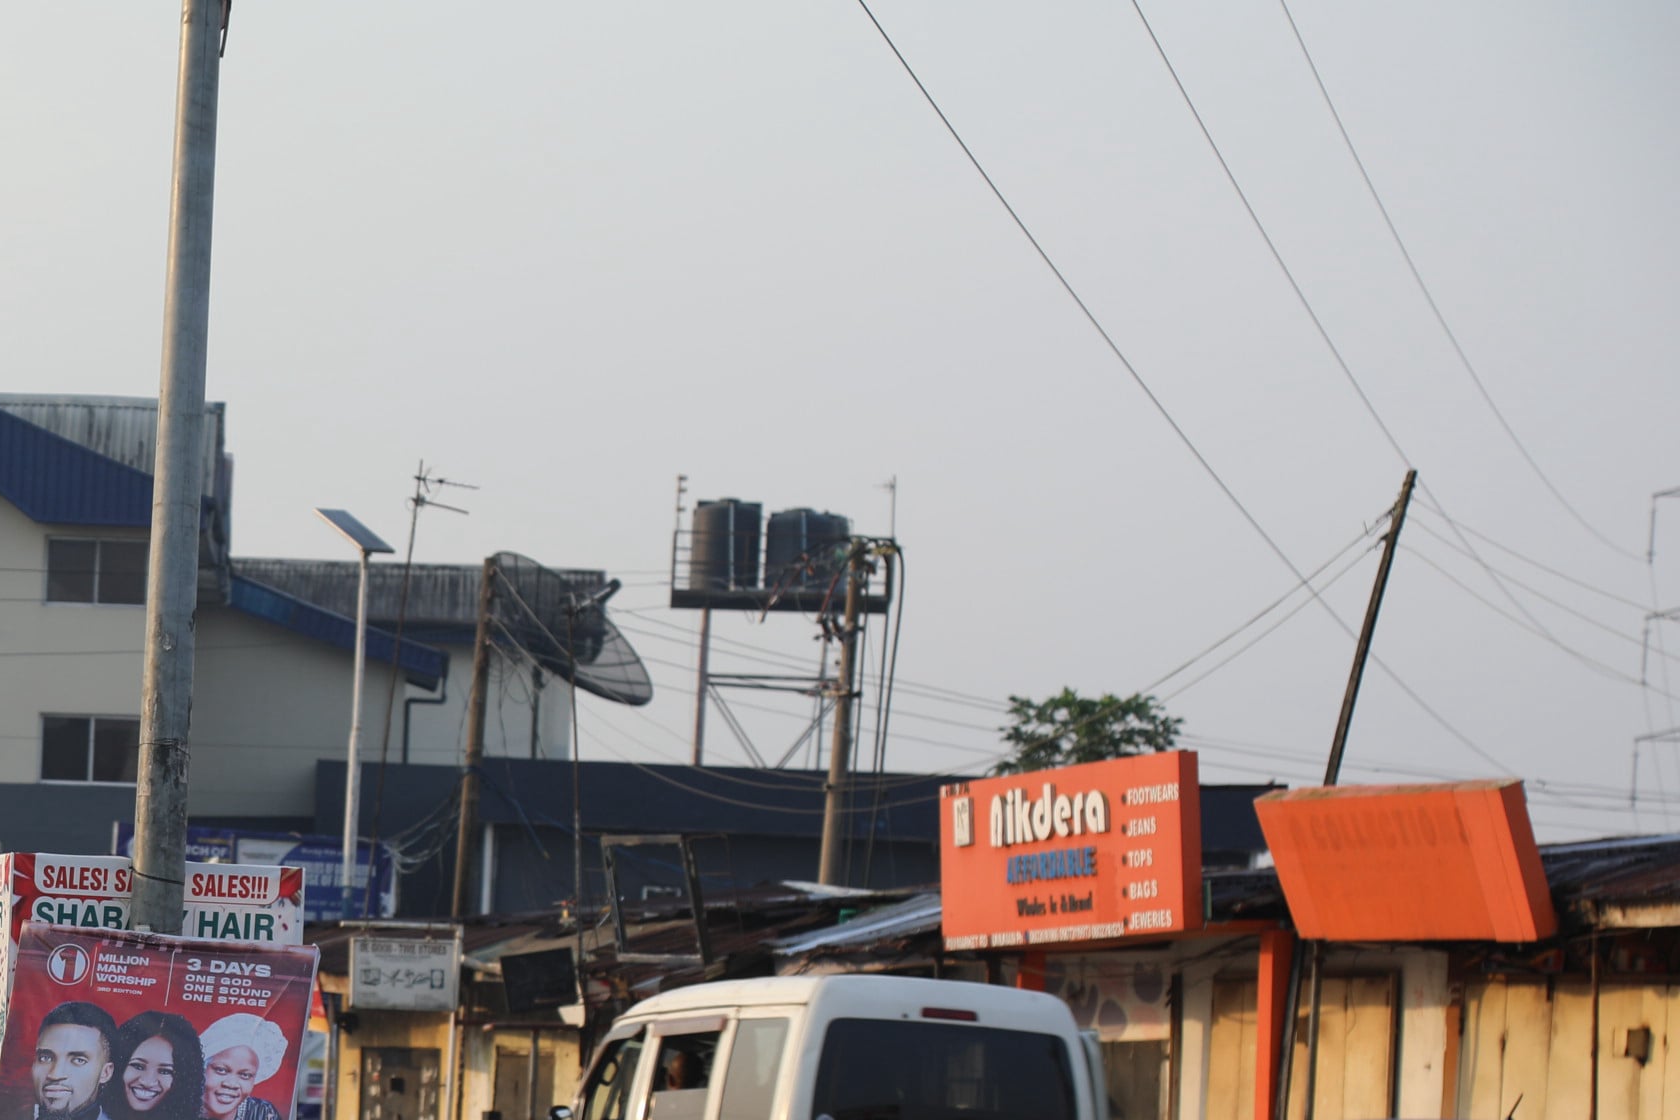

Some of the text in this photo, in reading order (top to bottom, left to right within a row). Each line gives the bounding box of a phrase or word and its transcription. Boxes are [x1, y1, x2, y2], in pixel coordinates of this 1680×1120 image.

[1127, 783, 1179, 806] FOOTWEARS
[1127, 816, 1157, 837] JEANS
[1006, 846, 1097, 885] AFFORDABLE
[1128, 848, 1153, 867] TOPS
[43, 864, 108, 892] SALES!
[191, 873, 269, 900] SALES!!!
[1129, 879, 1158, 900] BAGS
[198, 910, 275, 941] HAIR
[1128, 909, 1173, 930] JEWERIES
[97, 963, 128, 975] MAN
[98, 952, 151, 967] MILLION
[187, 958, 272, 978] 3 DAYS
[96, 973, 157, 987] WORSHIP
[185, 974, 252, 987] ONE GOD
[182, 993, 267, 1007] ONE STAGE
[184, 983, 272, 998] ONE SOUND
